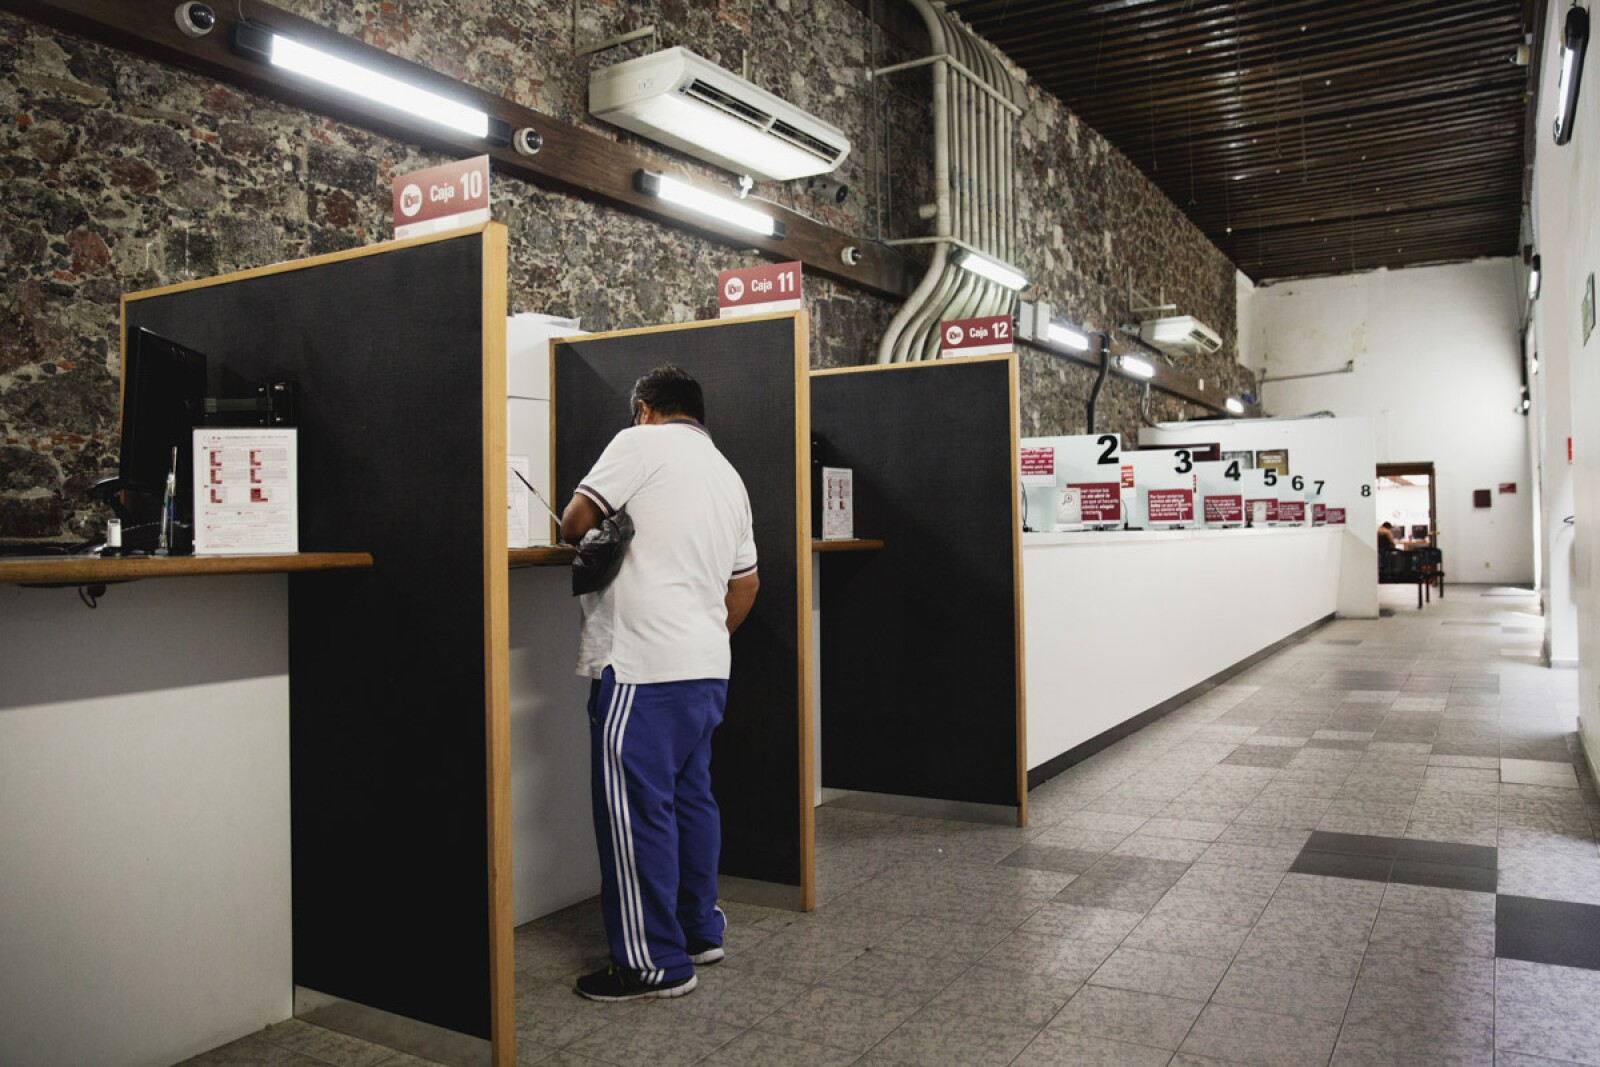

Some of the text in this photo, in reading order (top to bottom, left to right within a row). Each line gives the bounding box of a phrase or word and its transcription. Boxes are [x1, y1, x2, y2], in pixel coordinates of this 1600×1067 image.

[430, 183, 455, 204] Caja
[460, 170, 482, 201] 10
[751, 278, 773, 294] Caja
[777, 271, 794, 293] 11
[969, 326, 989, 340] Caja
[992, 322, 1009, 339] 12
[1097, 435, 1119, 464] 2
[1174, 449, 1193, 474] 3
[1224, 460, 1241, 481] 4
[1263, 468, 1277, 487] 5
[1291, 475, 1305, 491] 6
[1313, 480, 1325, 495] 7
[1361, 484, 1371, 497] 8
